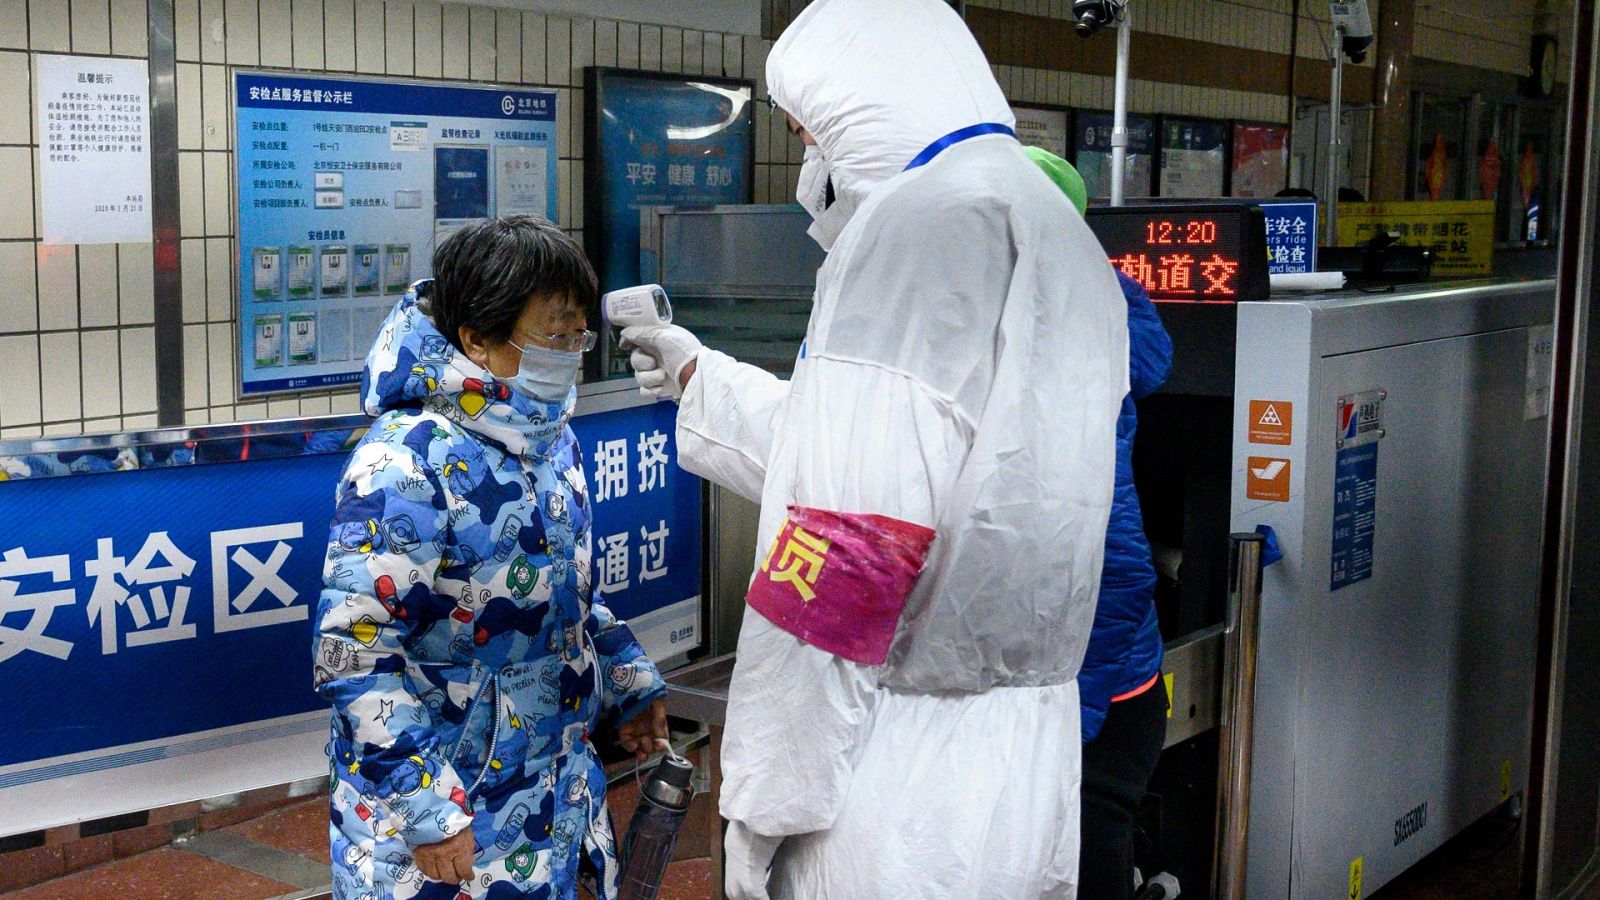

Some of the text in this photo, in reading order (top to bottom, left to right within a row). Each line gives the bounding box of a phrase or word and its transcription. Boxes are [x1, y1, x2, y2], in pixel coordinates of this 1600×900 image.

[78, 73, 114, 84] 温馨提示
[249, 86, 353, 104] 安检点服务监督公示栏
[626, 162, 656, 185] 平安
[667, 164, 695, 186] 健康
[1146, 221, 1215, 244] 12:20
[1285, 235, 1307, 244] ride
[1107, 254, 1239, 294] 轨道交
[1269, 264, 1306, 274] and liquid
[580, 429, 669, 503] 拥挤
[396, 476, 426, 493] WAKE
[597, 519, 670, 594] 通过
[0, 522, 309, 663] 安检区
